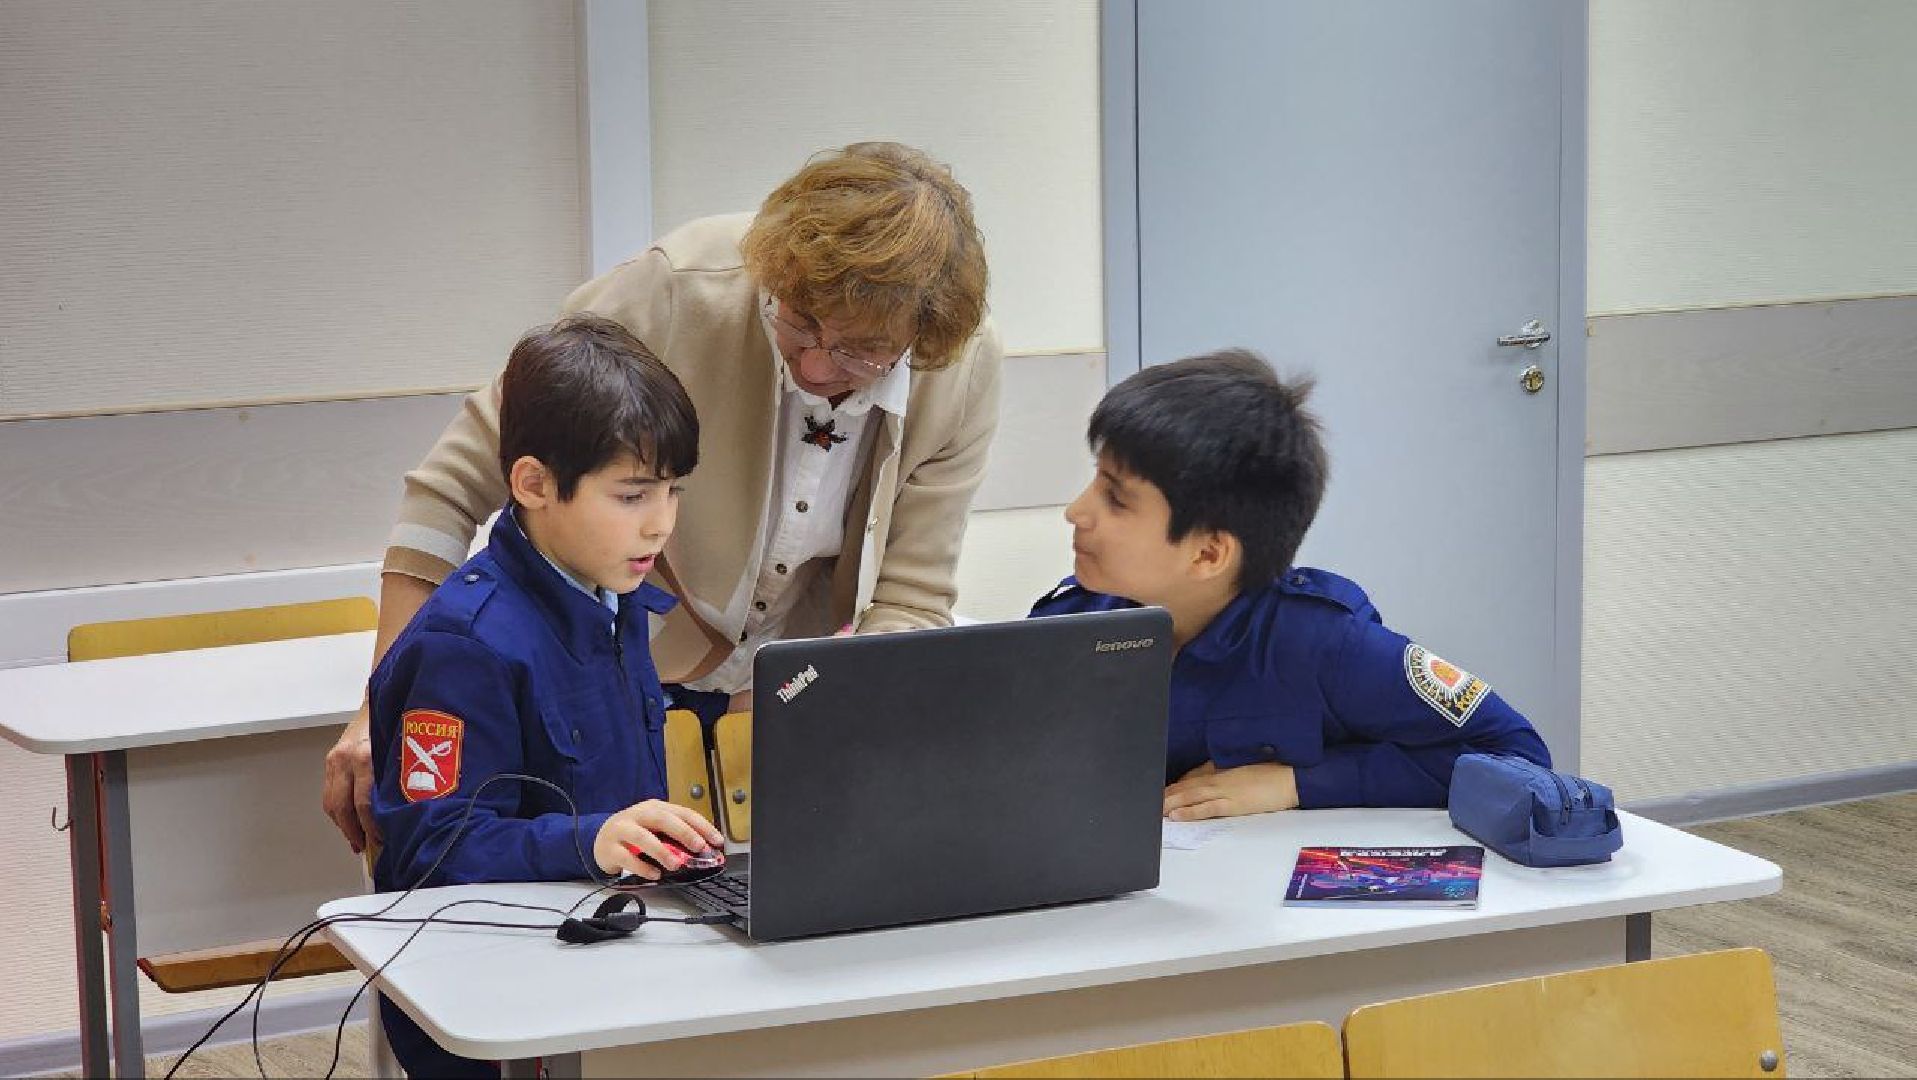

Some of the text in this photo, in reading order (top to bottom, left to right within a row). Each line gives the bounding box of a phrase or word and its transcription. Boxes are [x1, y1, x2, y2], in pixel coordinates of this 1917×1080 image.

[1095, 638, 1154, 652] lenovo
[776, 664, 819, 704] ThinkPad
[406, 720, 459, 738] РОССИЯ
